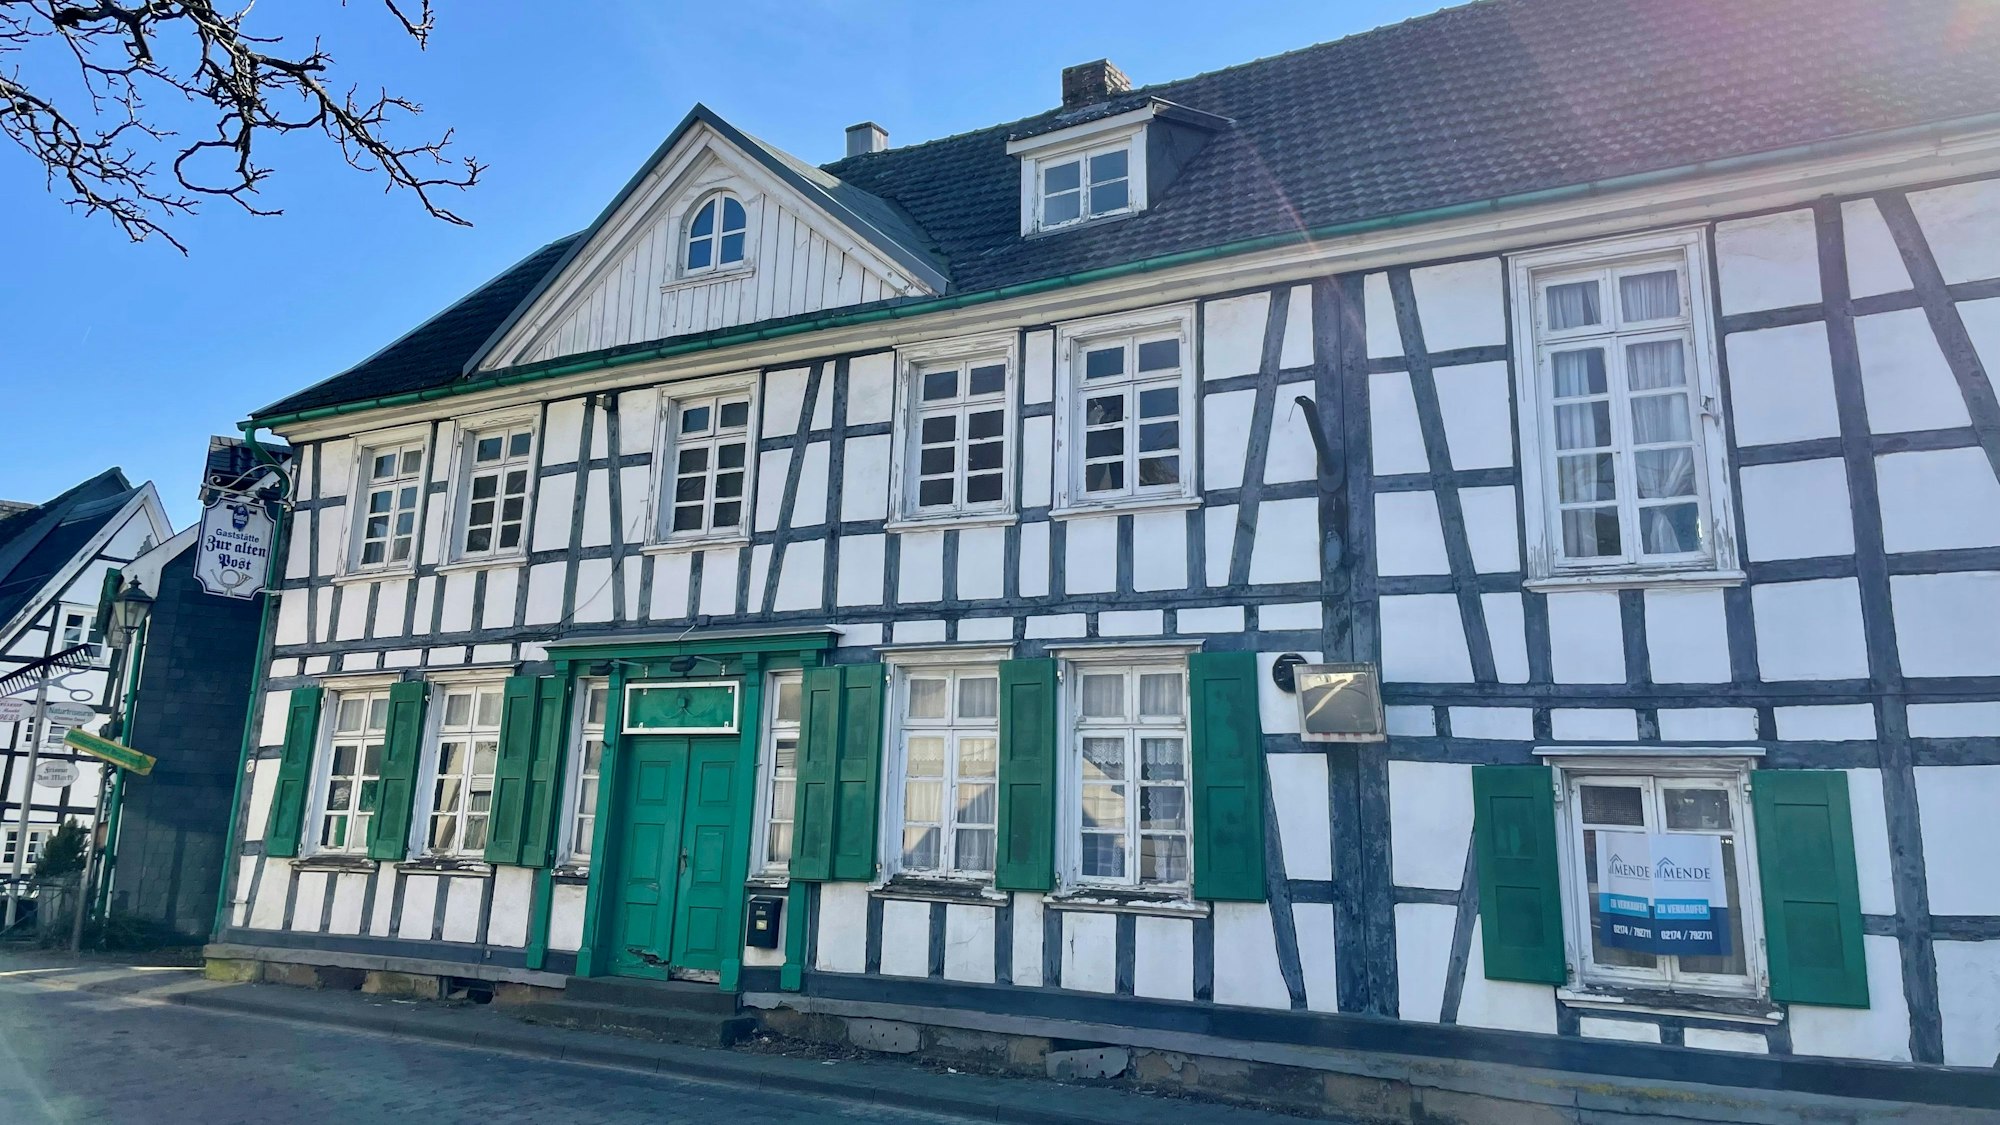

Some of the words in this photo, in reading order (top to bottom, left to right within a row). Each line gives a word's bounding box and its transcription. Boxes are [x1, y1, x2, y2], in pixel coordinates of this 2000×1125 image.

[216, 528, 259, 543] Gaststätte
[205, 535, 231, 552] Zur
[235, 542, 266, 557] alten
[219, 553, 251, 570] Post
[1614, 864, 1650, 878] MENDE
[1663, 867, 1711, 879] MENDE
[1657, 903, 1666, 914] ZU
[1613, 924, 1628, 935] 02174
[1633, 927, 1651, 938] 792711
[1661, 930, 1681, 940] 02174
[1689, 930, 1712, 940] 792711
